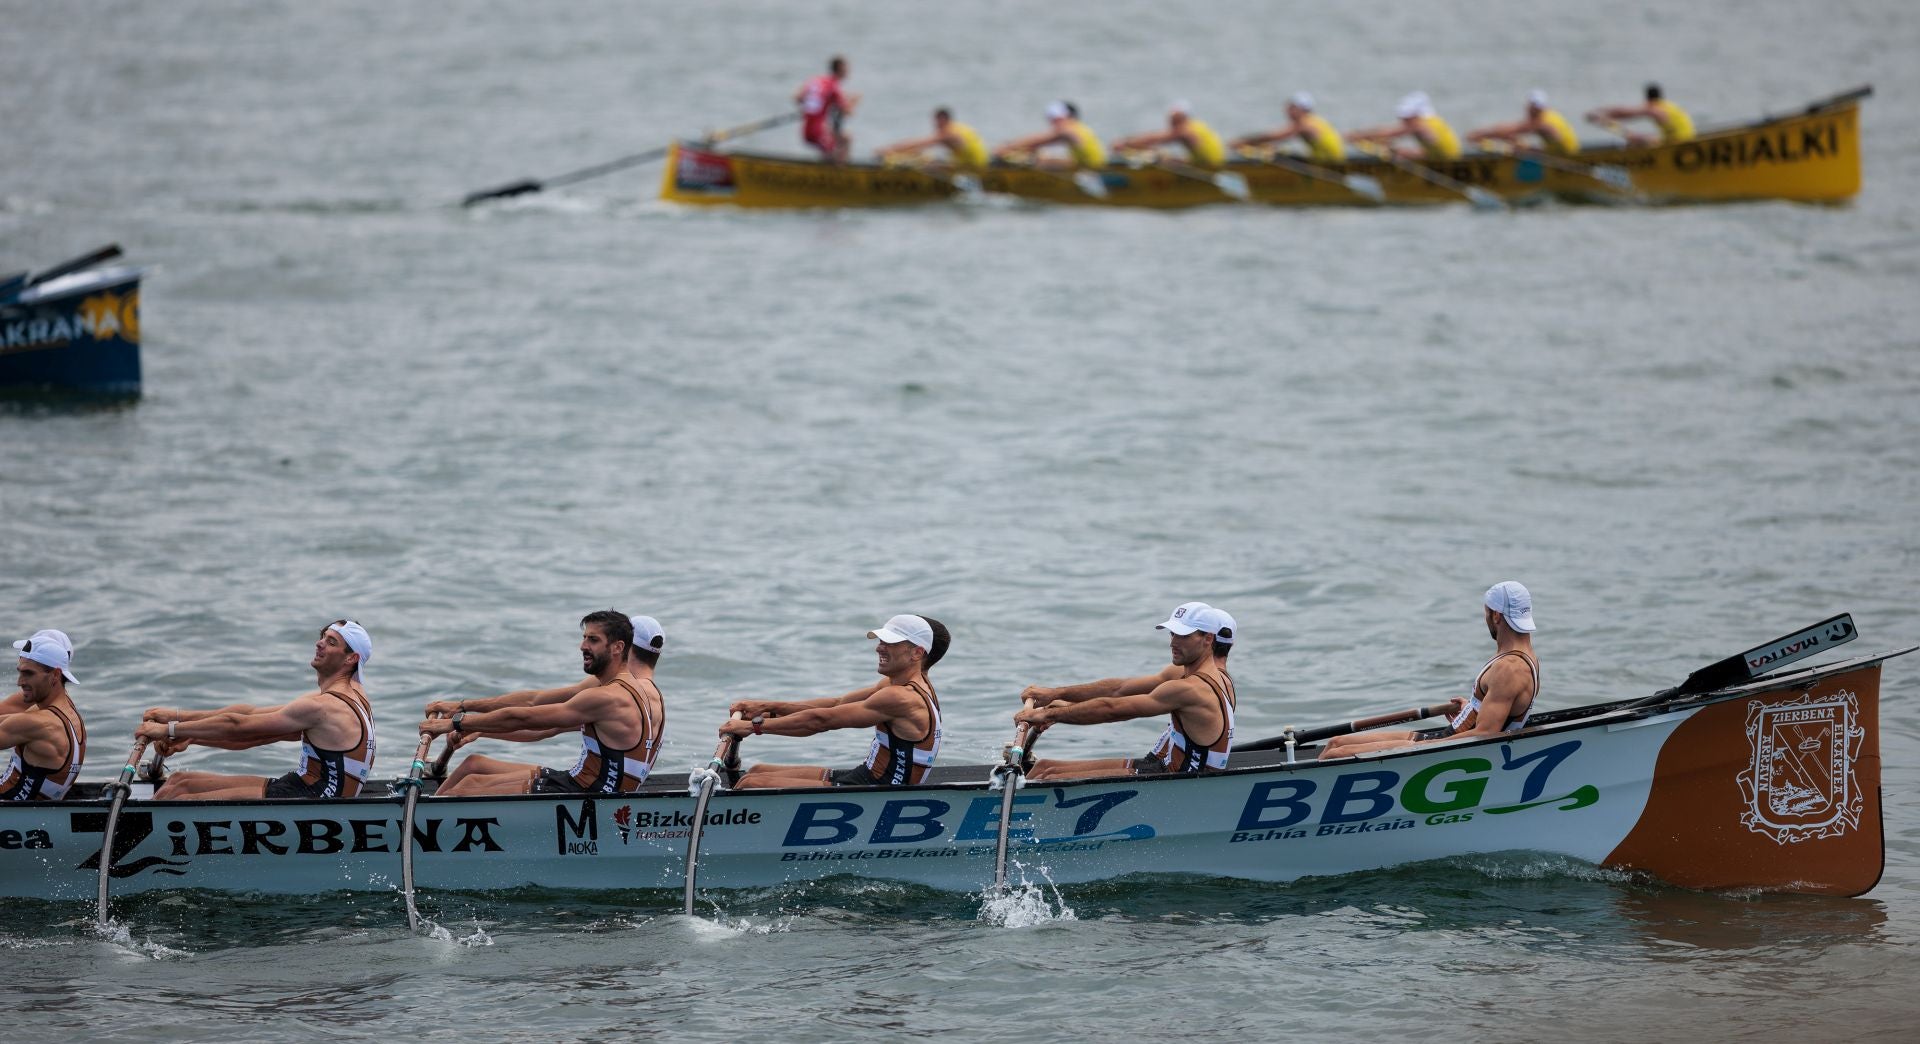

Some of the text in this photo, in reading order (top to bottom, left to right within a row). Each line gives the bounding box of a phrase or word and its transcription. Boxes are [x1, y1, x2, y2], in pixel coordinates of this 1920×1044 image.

[1673, 122, 1839, 171] ORIALKI
[1748, 636, 1819, 668] MATRA
[1833, 723, 1844, 795] ELKARTEA
[0, 829, 54, 850] ea
[1229, 812, 1475, 843] Bahía Bizkaia Gas
[847, 849, 874, 860] de
[876, 848, 959, 860] Bizkaia
